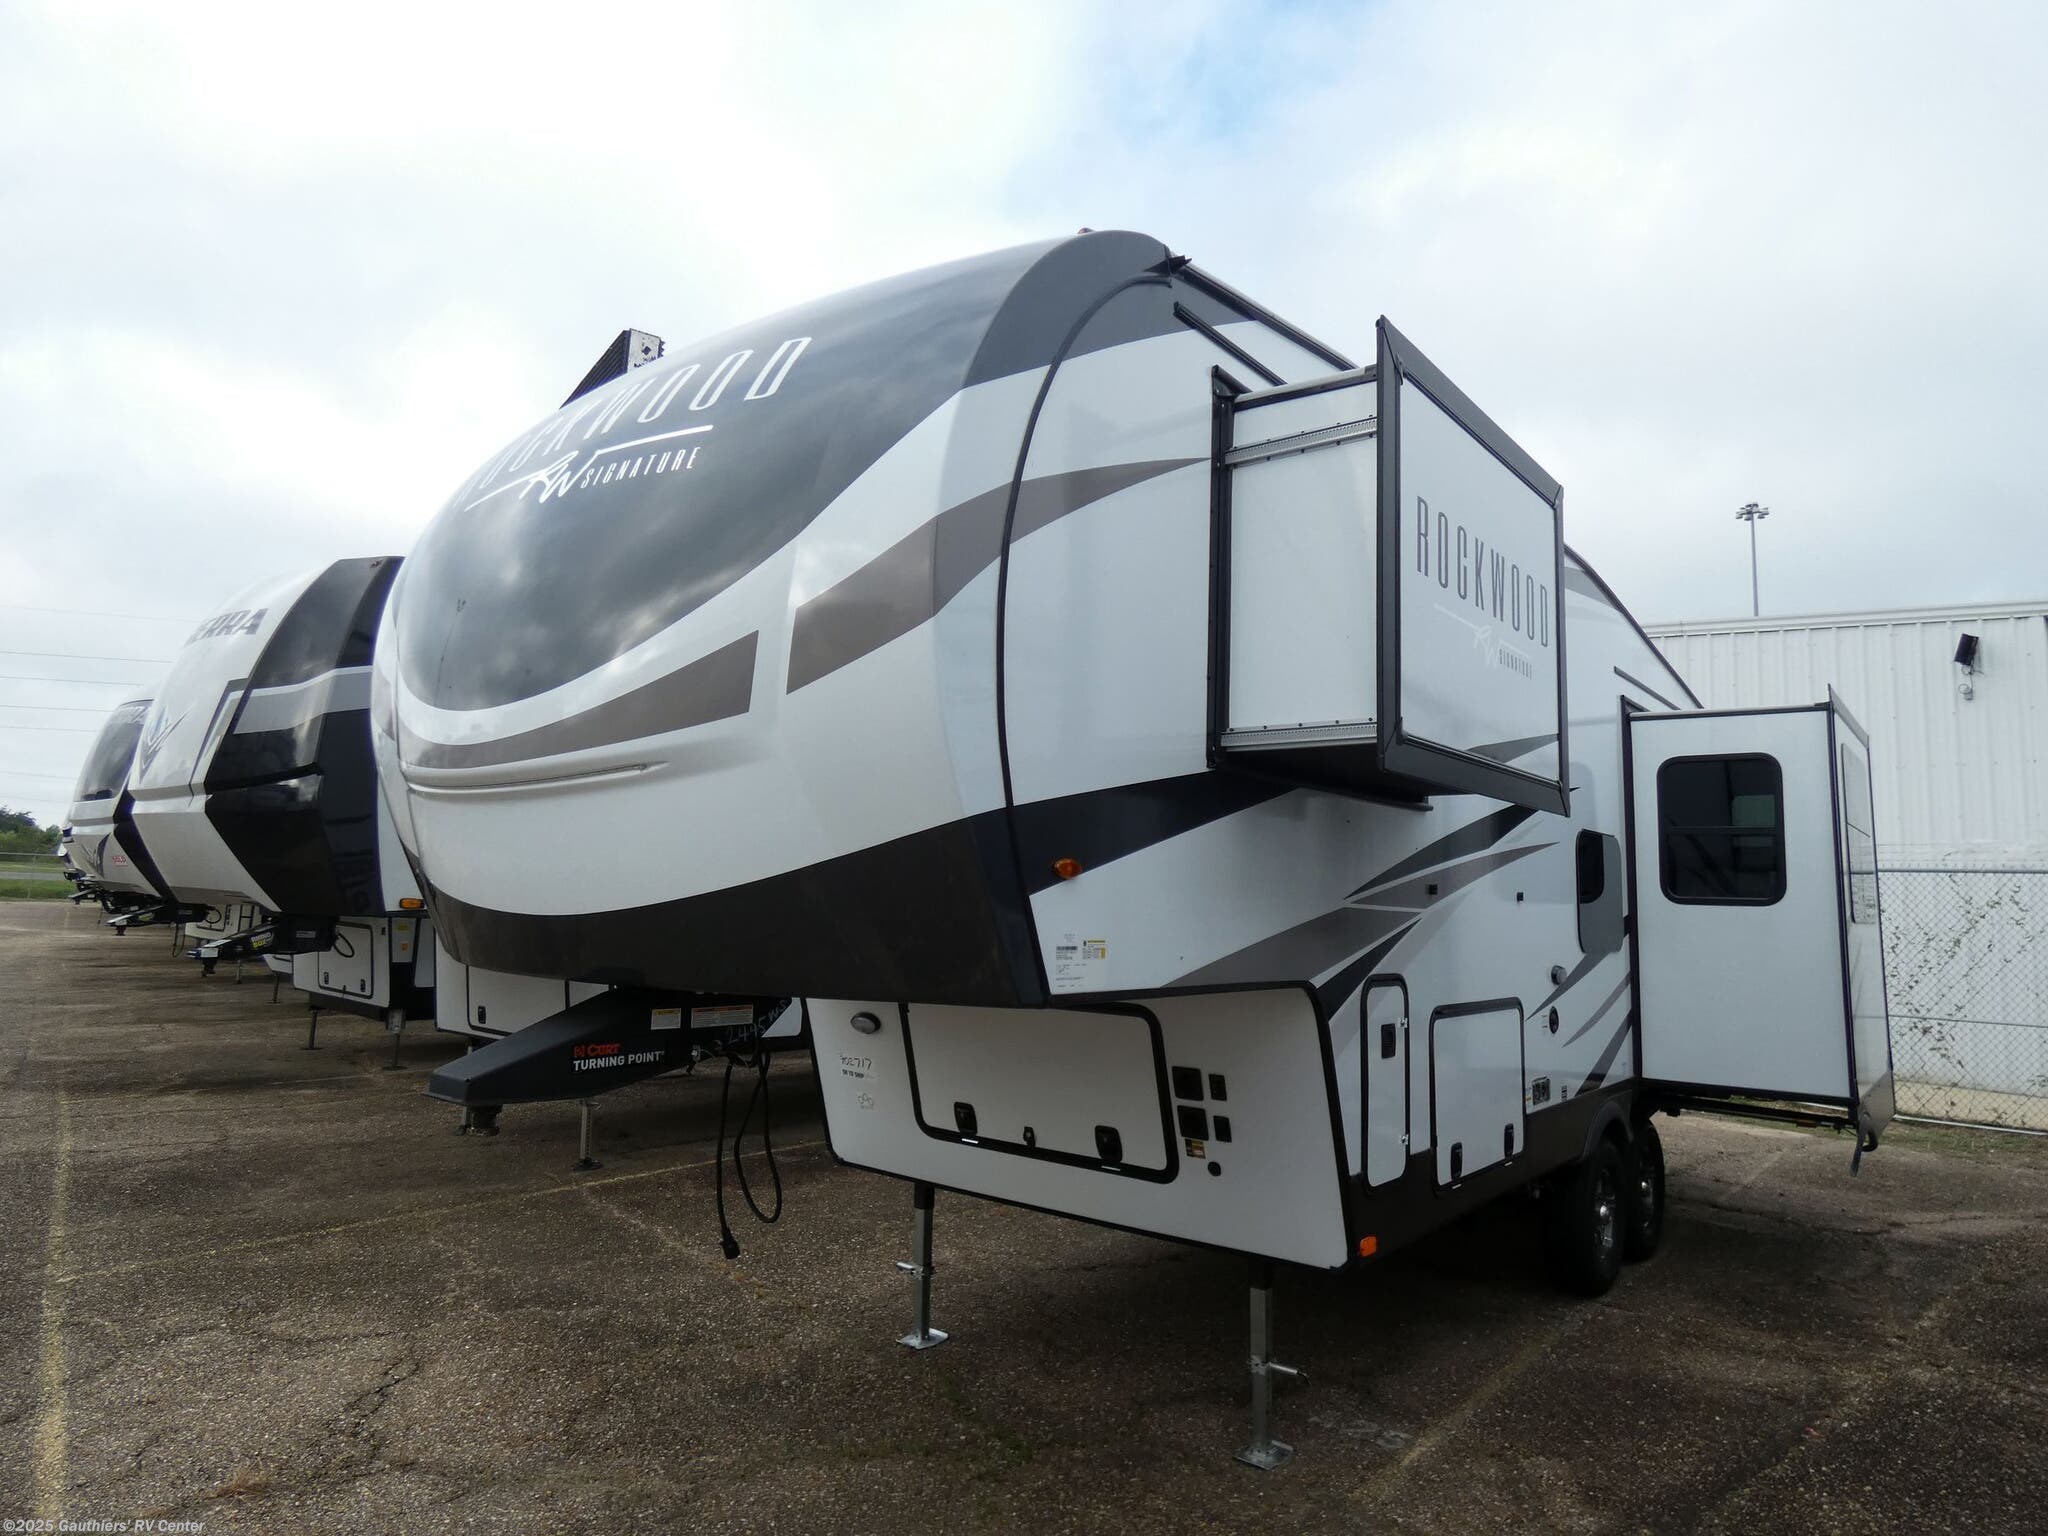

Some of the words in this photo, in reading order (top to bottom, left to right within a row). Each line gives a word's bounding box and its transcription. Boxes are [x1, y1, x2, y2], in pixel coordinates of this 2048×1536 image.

[580, 446, 701, 489] SIGNATURE
[1416, 495, 1548, 648] ROCKWOOD
[573, 1055, 625, 1072] TURNING
[628, 1050, 663, 1065] POINT
